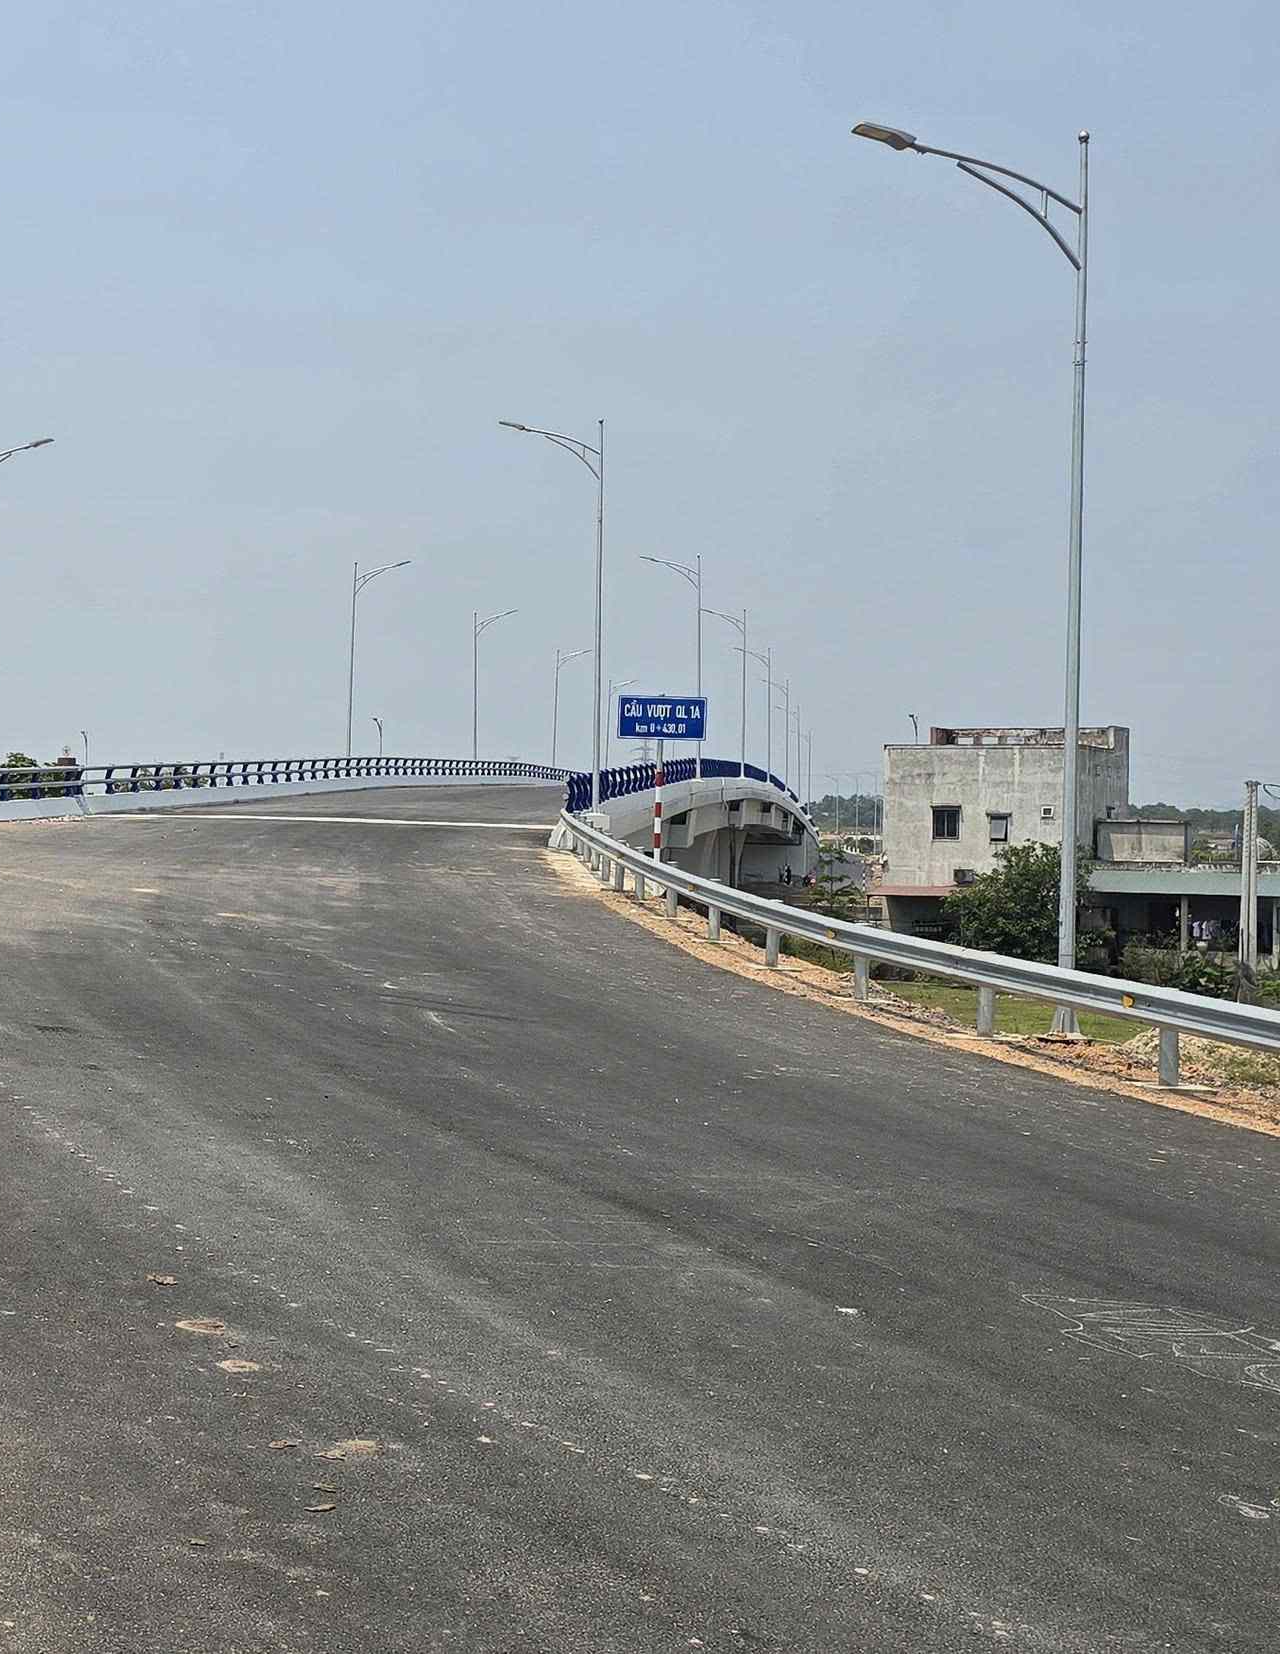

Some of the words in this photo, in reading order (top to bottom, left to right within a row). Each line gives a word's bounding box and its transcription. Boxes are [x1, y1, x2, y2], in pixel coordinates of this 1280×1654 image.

[624, 700, 642, 717] CẦU
[647, 704, 672, 720] VƯỢT
[676, 705, 688, 719] QL
[689, 705, 701, 719] 1A
[635, 722, 648, 733] km
